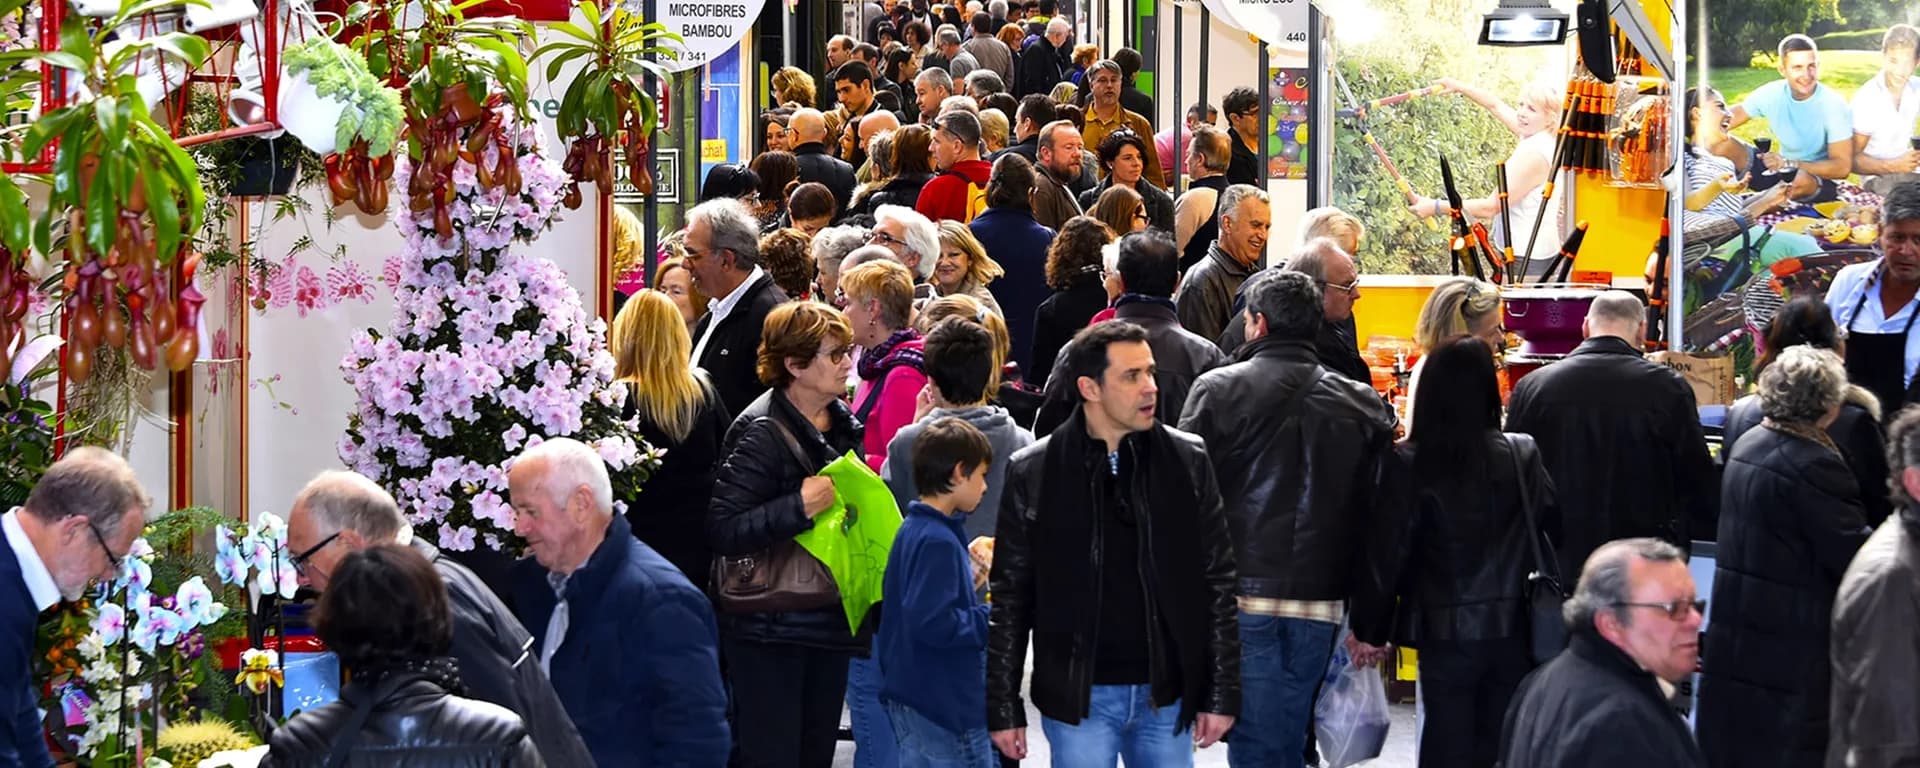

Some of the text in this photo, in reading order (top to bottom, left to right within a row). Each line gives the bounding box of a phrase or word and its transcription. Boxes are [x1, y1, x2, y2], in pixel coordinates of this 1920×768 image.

[669, 3, 746, 18] MICROFIBRES
[682, 24, 732, 38] BAMBOU
[1286, 32, 1306, 42] 440
[688, 51, 706, 61] 341
